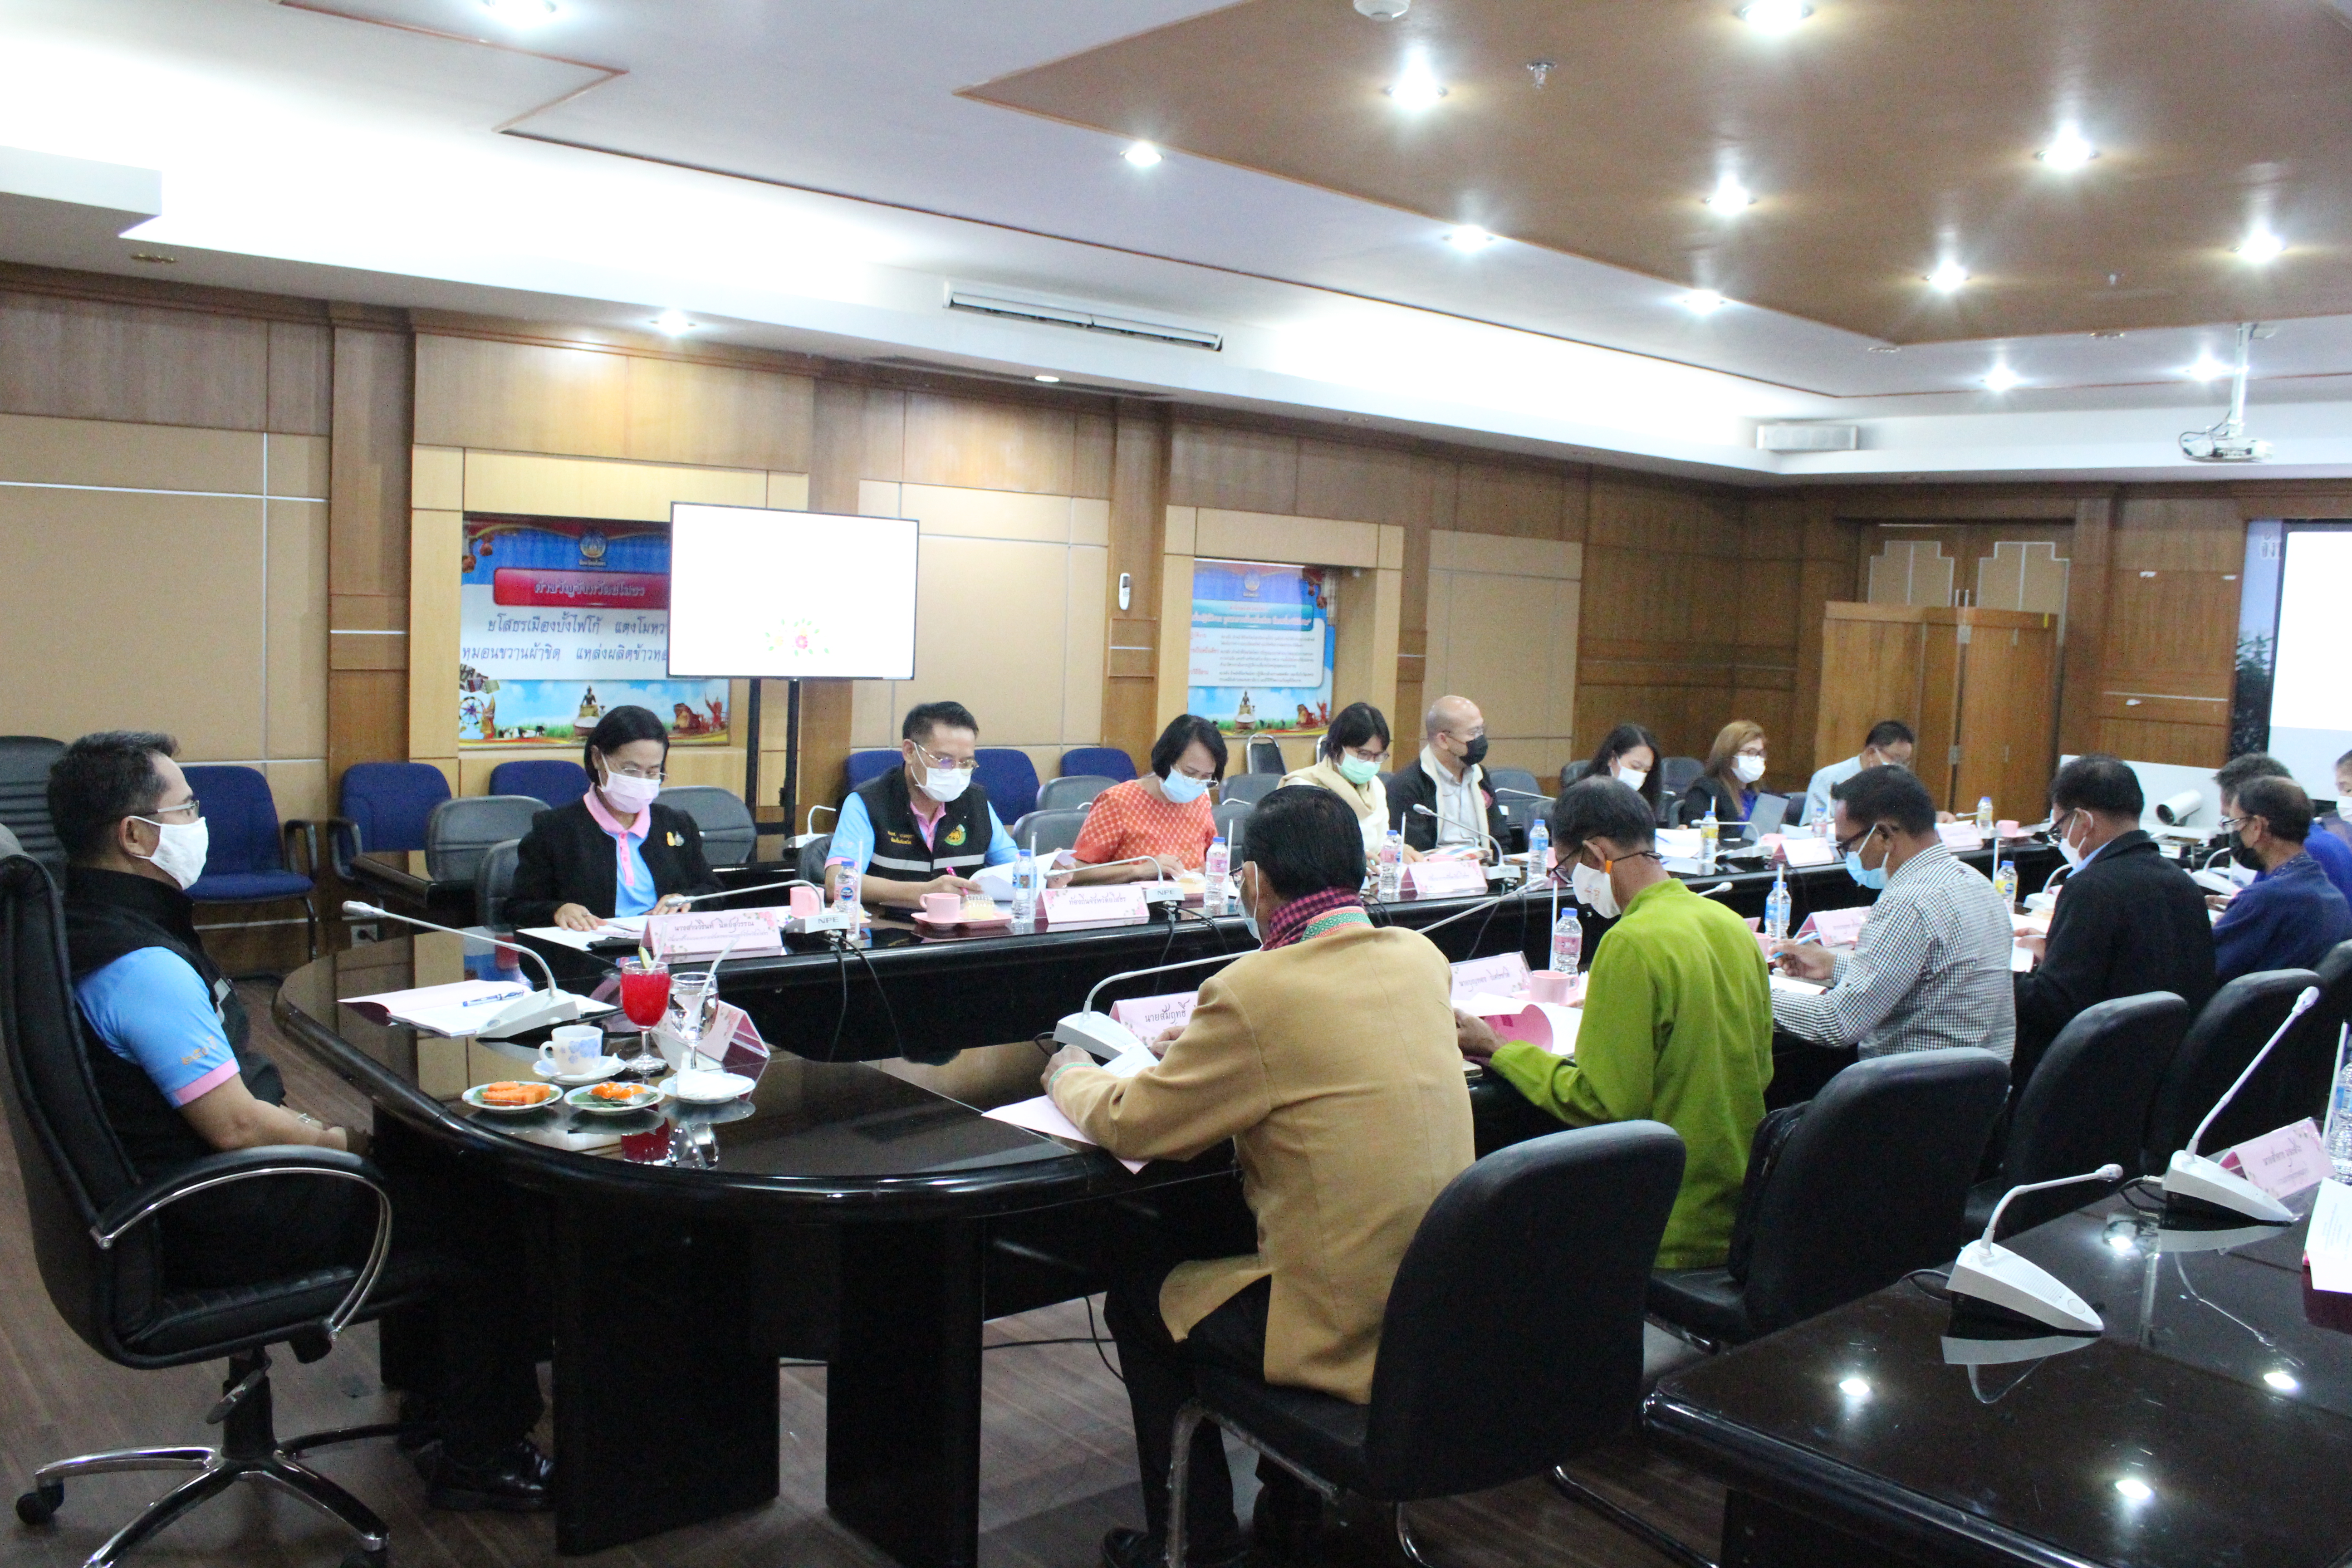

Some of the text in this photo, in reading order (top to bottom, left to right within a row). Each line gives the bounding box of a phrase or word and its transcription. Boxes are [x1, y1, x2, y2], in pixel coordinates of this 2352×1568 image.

[488, 611, 603, 635] ยโสธรเมืองบั้งไฟโก้
[1069, 892, 1126, 906] ท้องถิ่นจังหวัดยโสธร
[1145, 998, 1190, 1024] นายสัมฤทธิ์
